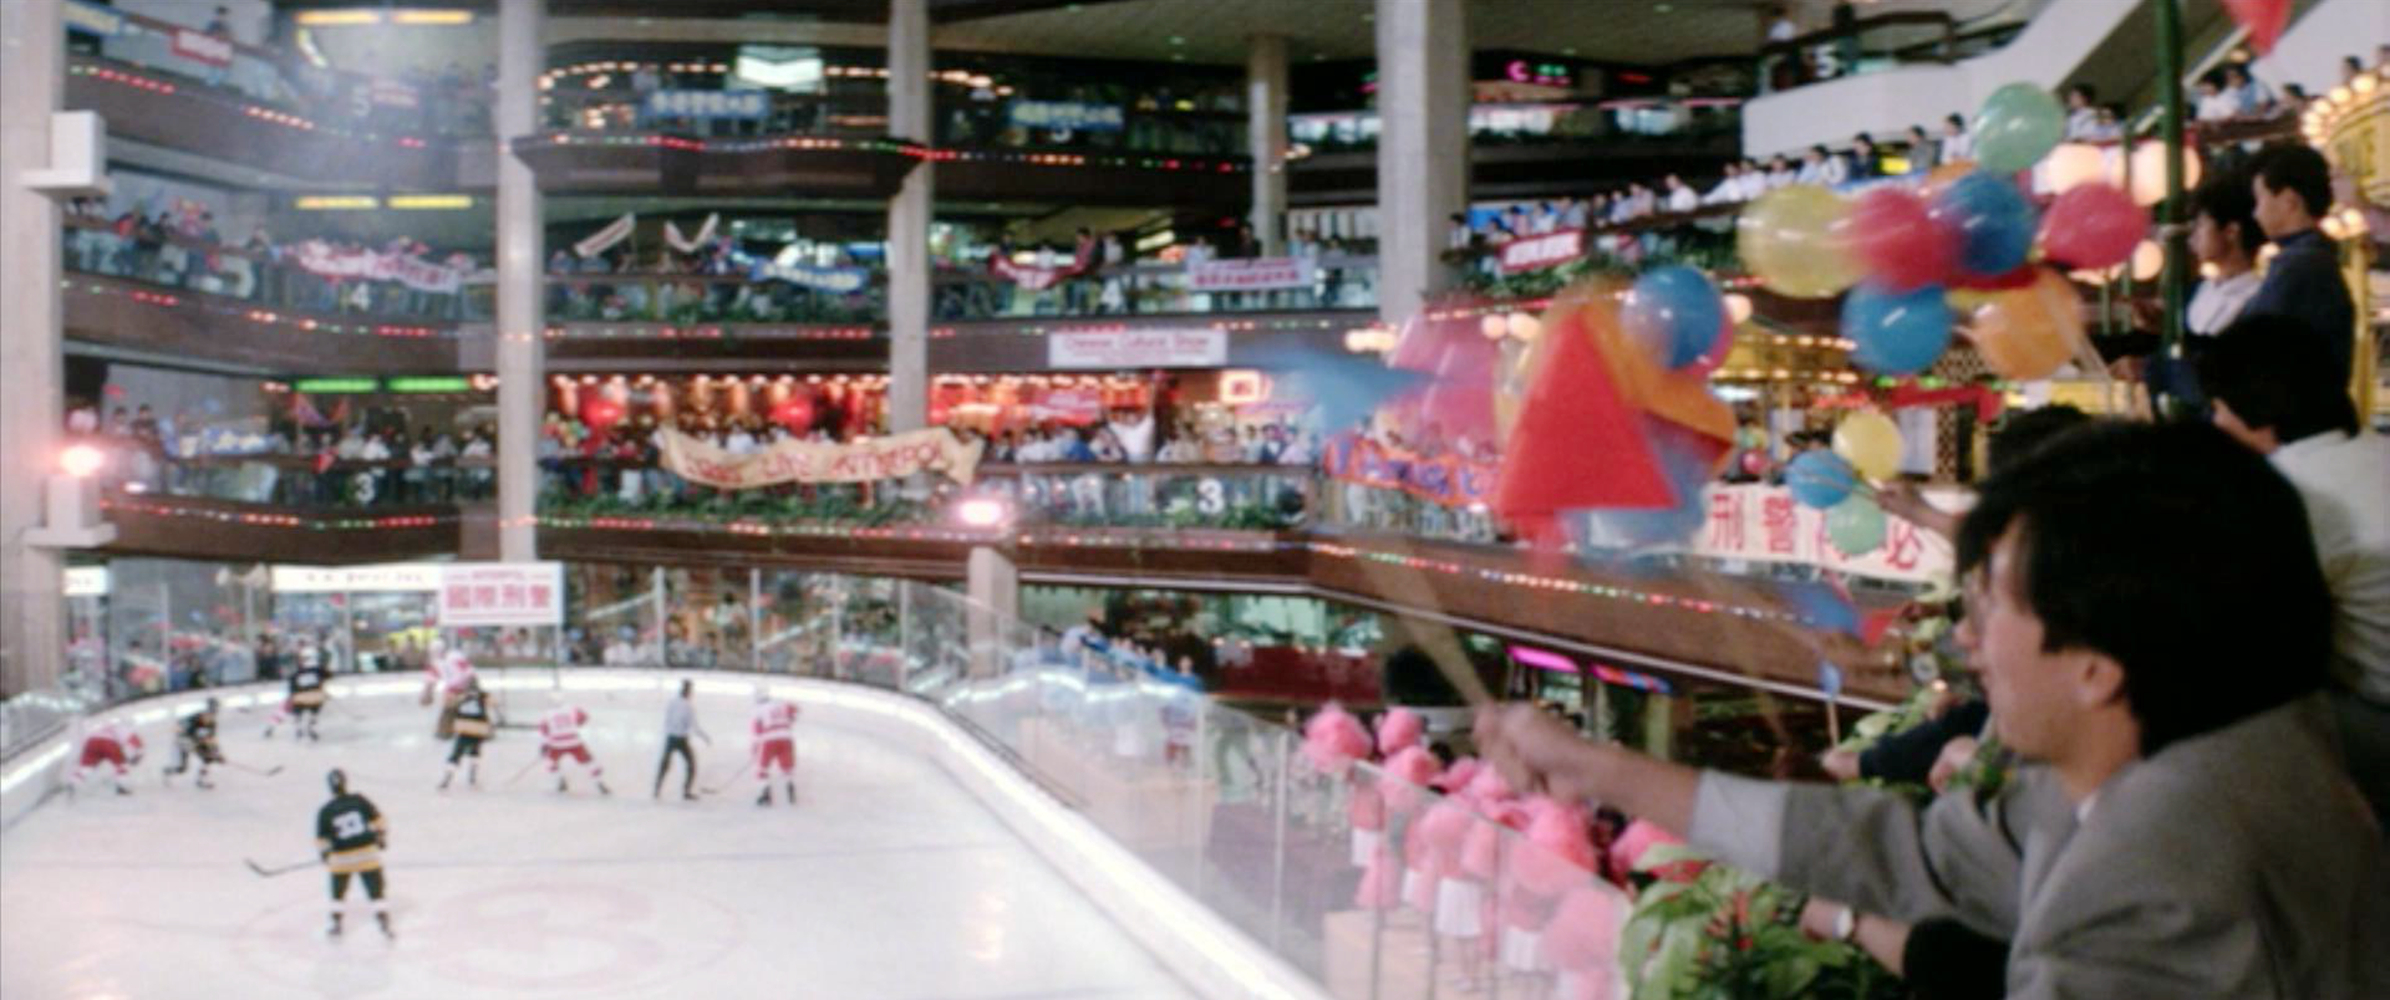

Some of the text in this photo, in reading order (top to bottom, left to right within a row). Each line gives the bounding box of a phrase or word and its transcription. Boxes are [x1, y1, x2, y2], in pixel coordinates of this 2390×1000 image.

[1815, 45, 1837, 78] 5
[355, 473, 375, 502] 3
[1198, 479, 1224, 514] 3
